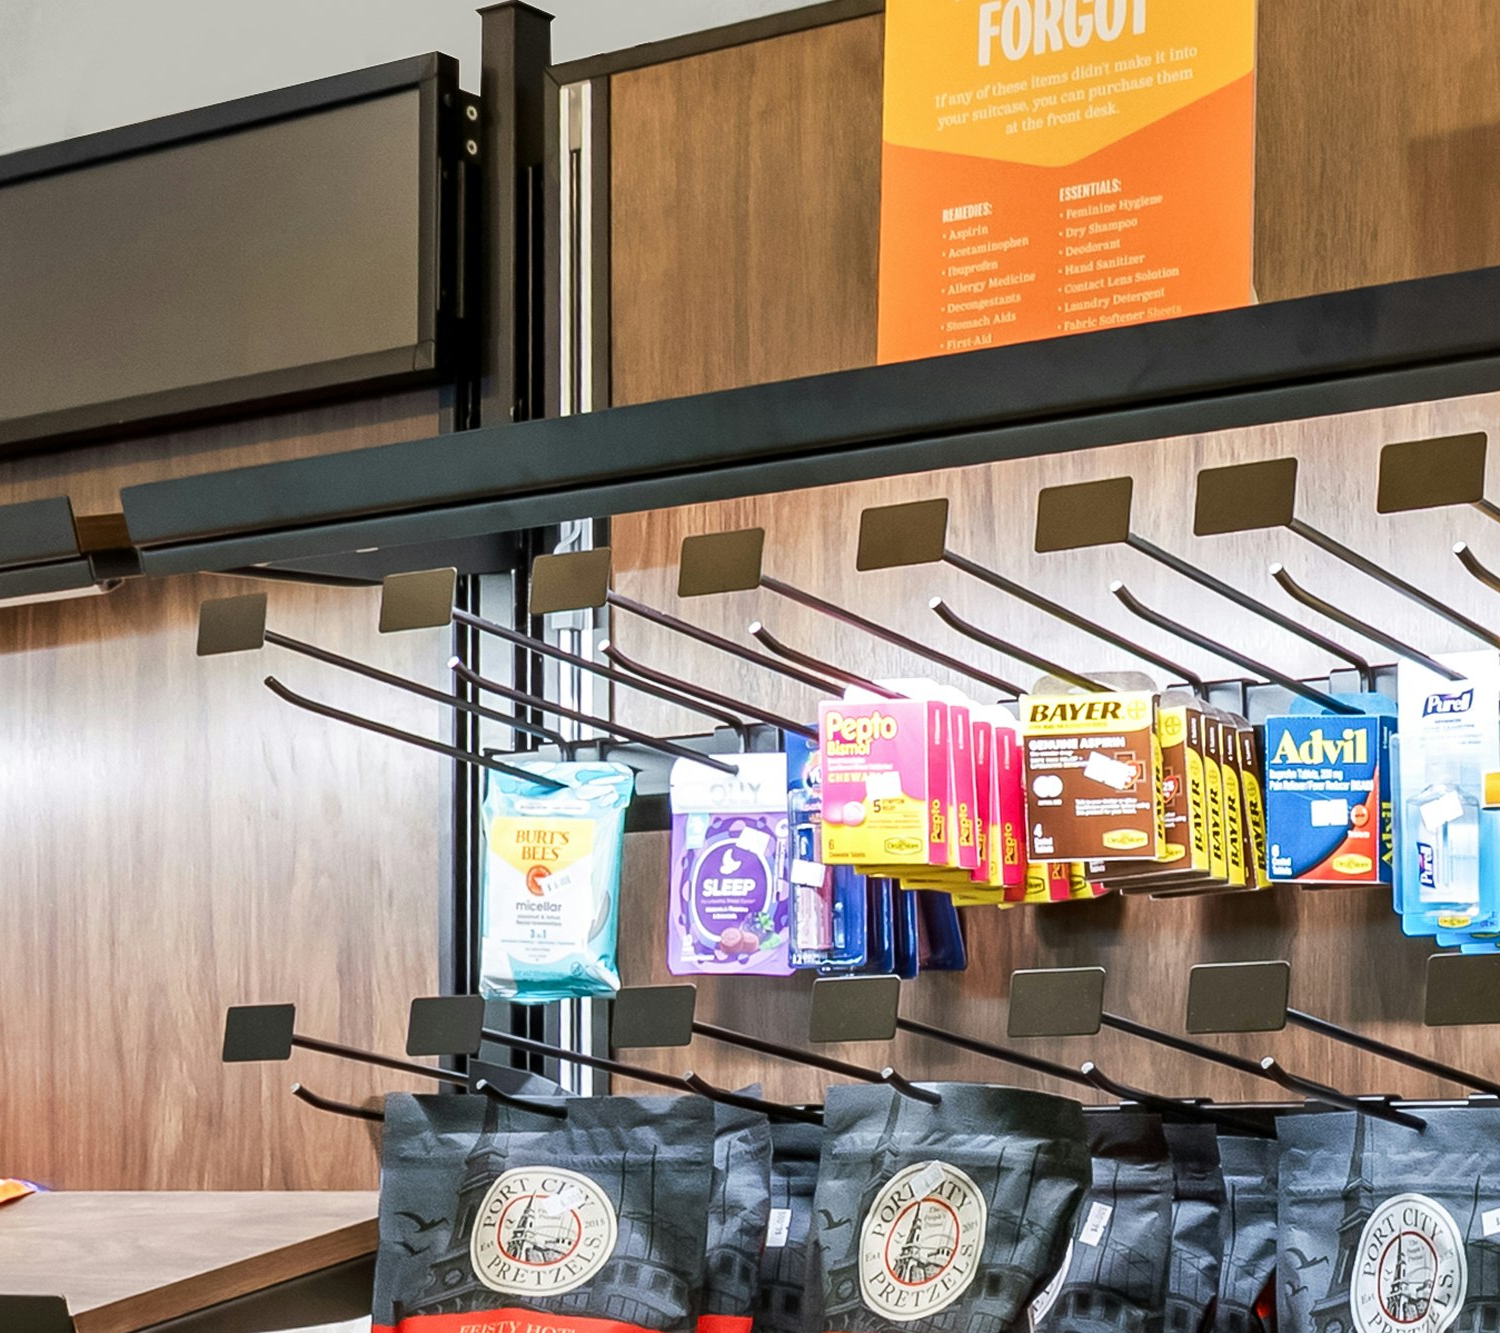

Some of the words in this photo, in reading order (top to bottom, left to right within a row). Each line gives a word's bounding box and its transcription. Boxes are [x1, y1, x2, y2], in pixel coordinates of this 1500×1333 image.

[935, 93, 948, 108] If
[949, 89, 972, 107] any
[976, 84, 990, 100] of
[991, 81, 1027, 97] these
[1031, 73, 1068, 89] items
[1071, 61, 1109, 80] didn't
[1115, 55, 1152, 72] make
[1155, 50, 1165, 64] it
[1170, 46, 1198, 60] into
[936, 113, 968, 131] your
[972, 101, 1029, 121] suitcase,
[1032, 97, 1057, 112] you
[1061, 90, 1084, 104] can
[1088, 76, 1152, 102] purchase
[1157, 67, 1193, 85] them
[1006, 121, 1018, 134] at
[1022, 115, 1044, 132] the
[1047, 110, 1081, 127] front
[1085, 102, 1119, 119] desk.
[1060, 178, 1121, 202] ESSENTIALS:
[942, 202, 993, 223] REMEDIES:
[1066, 203, 1116, 219] Feminine
[1119, 194, 1163, 211] Hygiene
[949, 225, 989, 242] Aspirin
[1065, 227, 1085, 239] Dry
[1088, 218, 1138, 235] Shampoo
[948, 236, 1029, 258] Acetaminophen
[1065, 239, 1121, 256] Deodorant
[948, 260, 998, 278] Ibuprofen
[1065, 263, 1094, 276] Hand
[1096, 254, 1145, 271] Sanitizer
[948, 281, 986, 295] Allergy
[989, 272, 1036, 288] Medicine
[1064, 279, 1105, 294] Contact
[1107, 275, 1133, 287] Lens
[1134, 266, 1179, 283] Solution
[947, 293, 1021, 313] Decongestants
[1064, 296, 1110, 313] Laundry
[1113, 288, 1165, 306] Detergent
[946, 317, 991, 331] Stomach
[993, 311, 1017, 323] Aids
[1064, 318, 1097, 331] Fabric
[1099, 309, 1145, 325] Softener
[1147, 304, 1182, 318] Sheets
[947, 334, 992, 349] First-Aid
[1030, 702, 1121, 722] BAYER
[1426, 693, 1471, 714] Purell
[826, 710, 898, 745] Pepto
[827, 740, 872, 758] Bismol
[1029, 738, 1078, 751] GENUINE
[1080, 737, 1125, 750] ASPIRIN
[1271, 729, 1368, 766] Advil
[930, 798, 945, 843] Pepto
[516, 830, 570, 845] BURT'S
[521, 846, 560, 861] BEES
[1420, 845, 1433, 886] Purell
[702, 879, 756, 898] SLEEP
[516, 900, 562, 912] micellar
[483, 1178, 530, 1228] PORT
[1364, 1214, 1397, 1277] PORT
[1403, 1207, 1444, 1242] CITY
